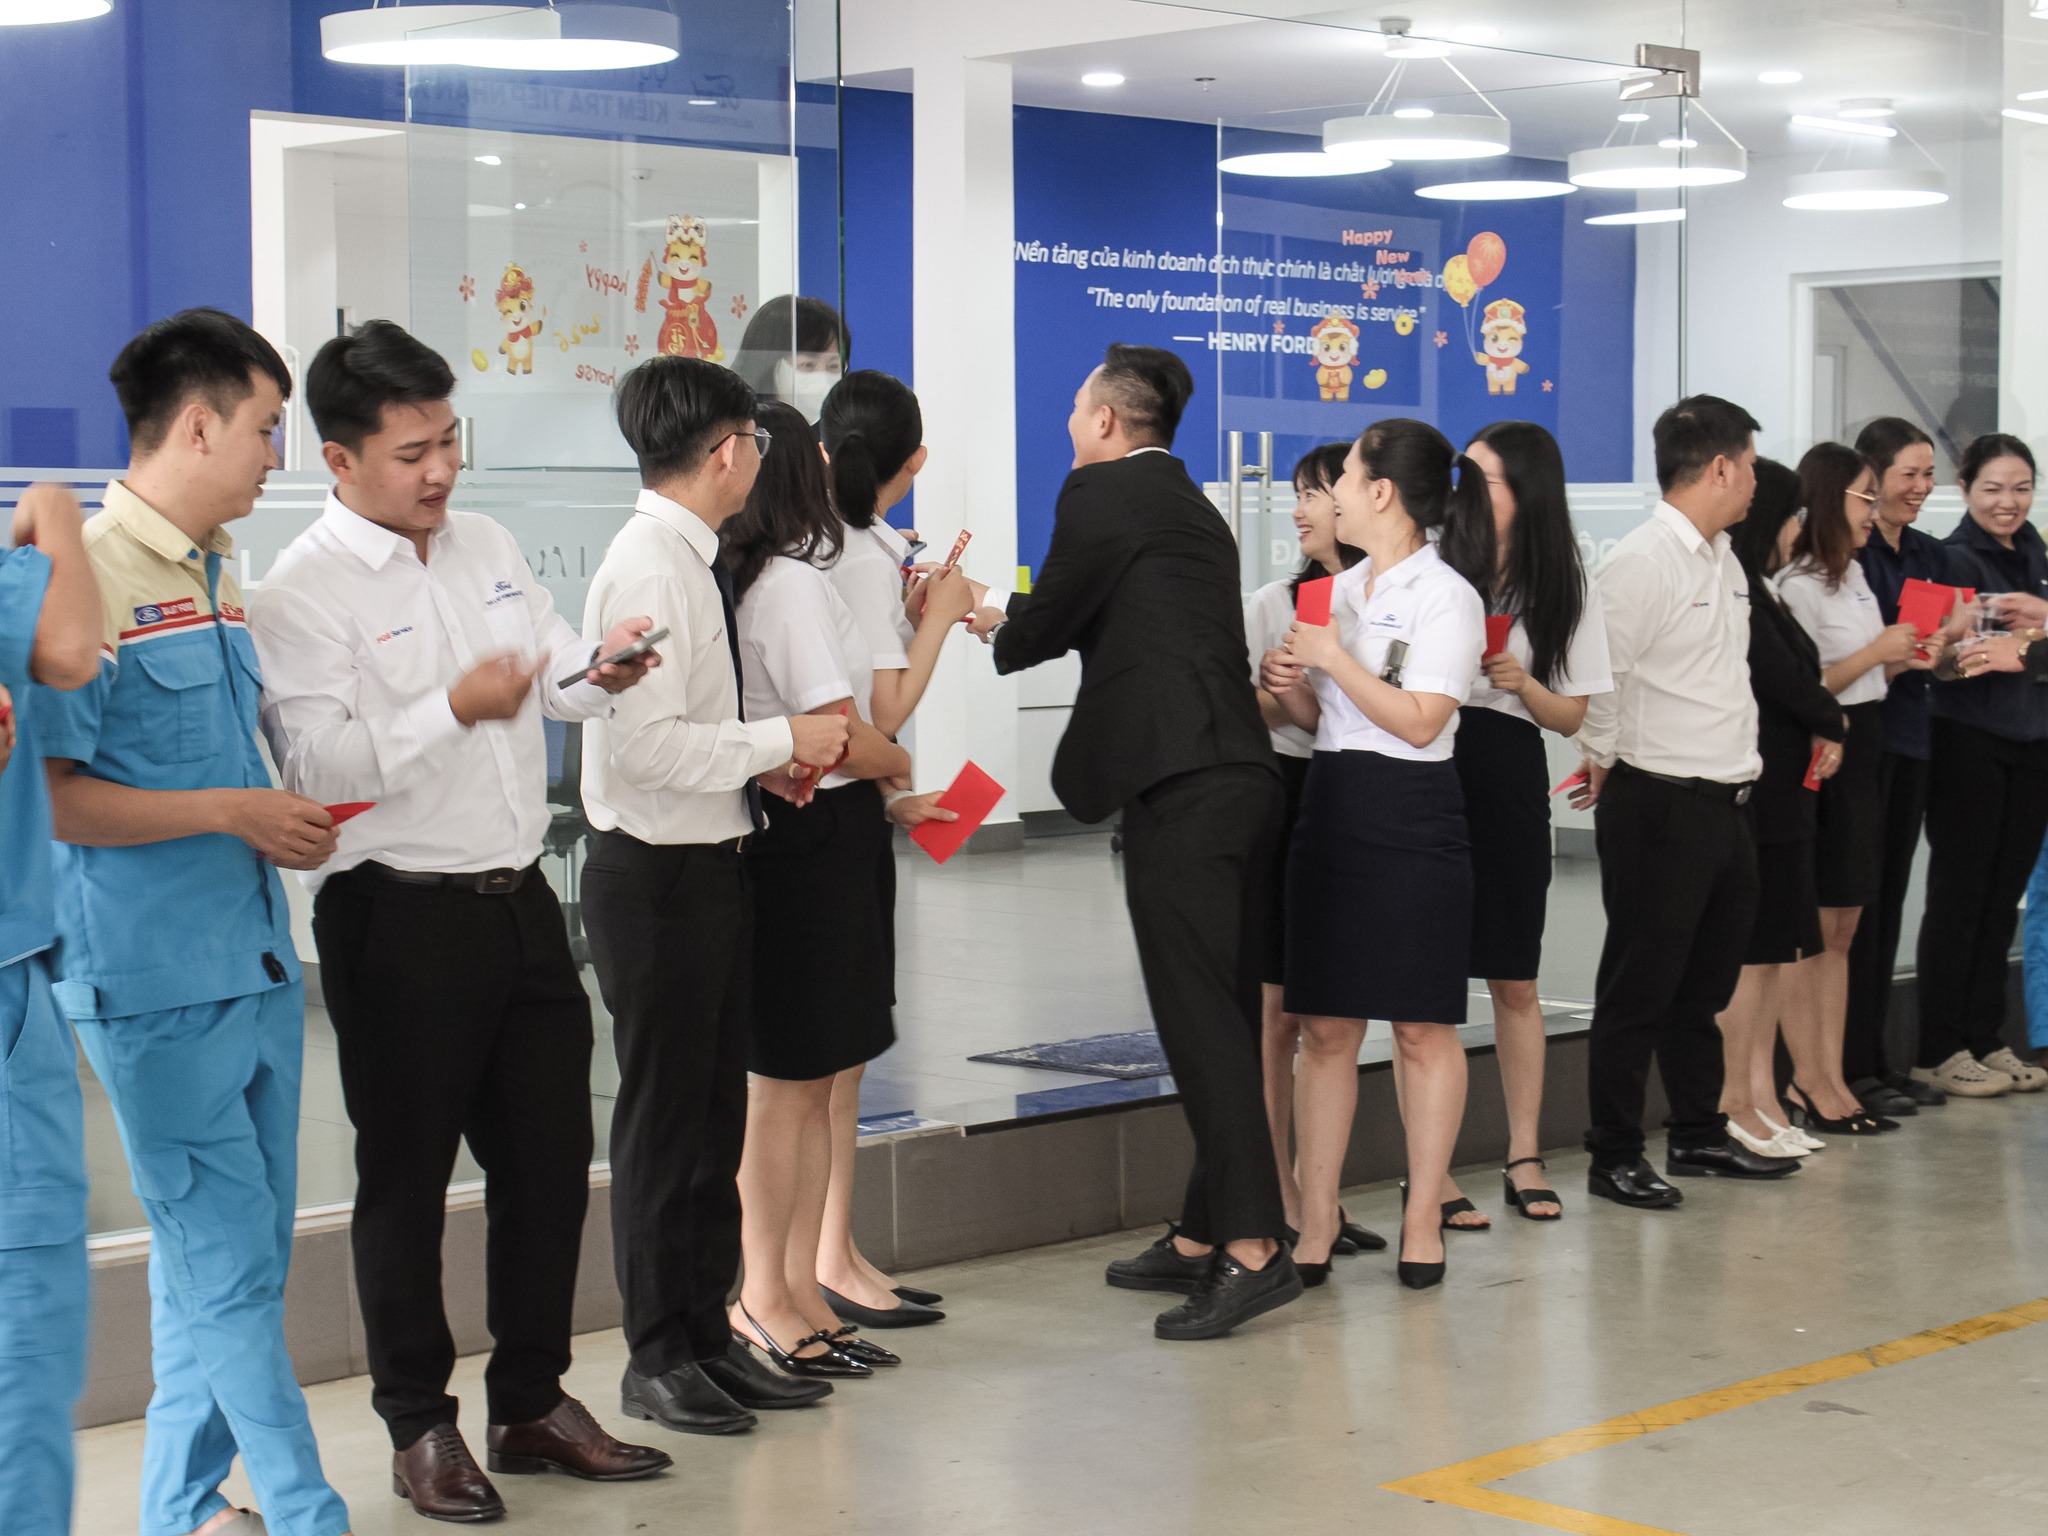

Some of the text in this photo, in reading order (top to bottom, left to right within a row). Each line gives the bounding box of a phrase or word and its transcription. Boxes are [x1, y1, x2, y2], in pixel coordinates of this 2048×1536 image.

[1342, 229, 1393, 246] Happy
[1052, 242, 1088, 269] tảng
[1091, 246, 1120, 267] của
[1122, 248, 1155, 269] kinh
[1157, 251, 1206, 272] doanh
[1242, 257, 1275, 279] thực
[1276, 260, 1316, 280] chính
[1318, 261, 1332, 280] là
[1333, 261, 1366, 283] chất
[1376, 249, 1410, 265] New
[1126, 290, 1160, 313] only
[1161, 291, 1242, 314] foundation
[1244, 295, 1263, 316] of
[1263, 297, 1292, 315] real
[1293, 298, 1354, 319] business
[1356, 304, 1368, 320] is
[1208, 332, 1269, 353] HENRY
